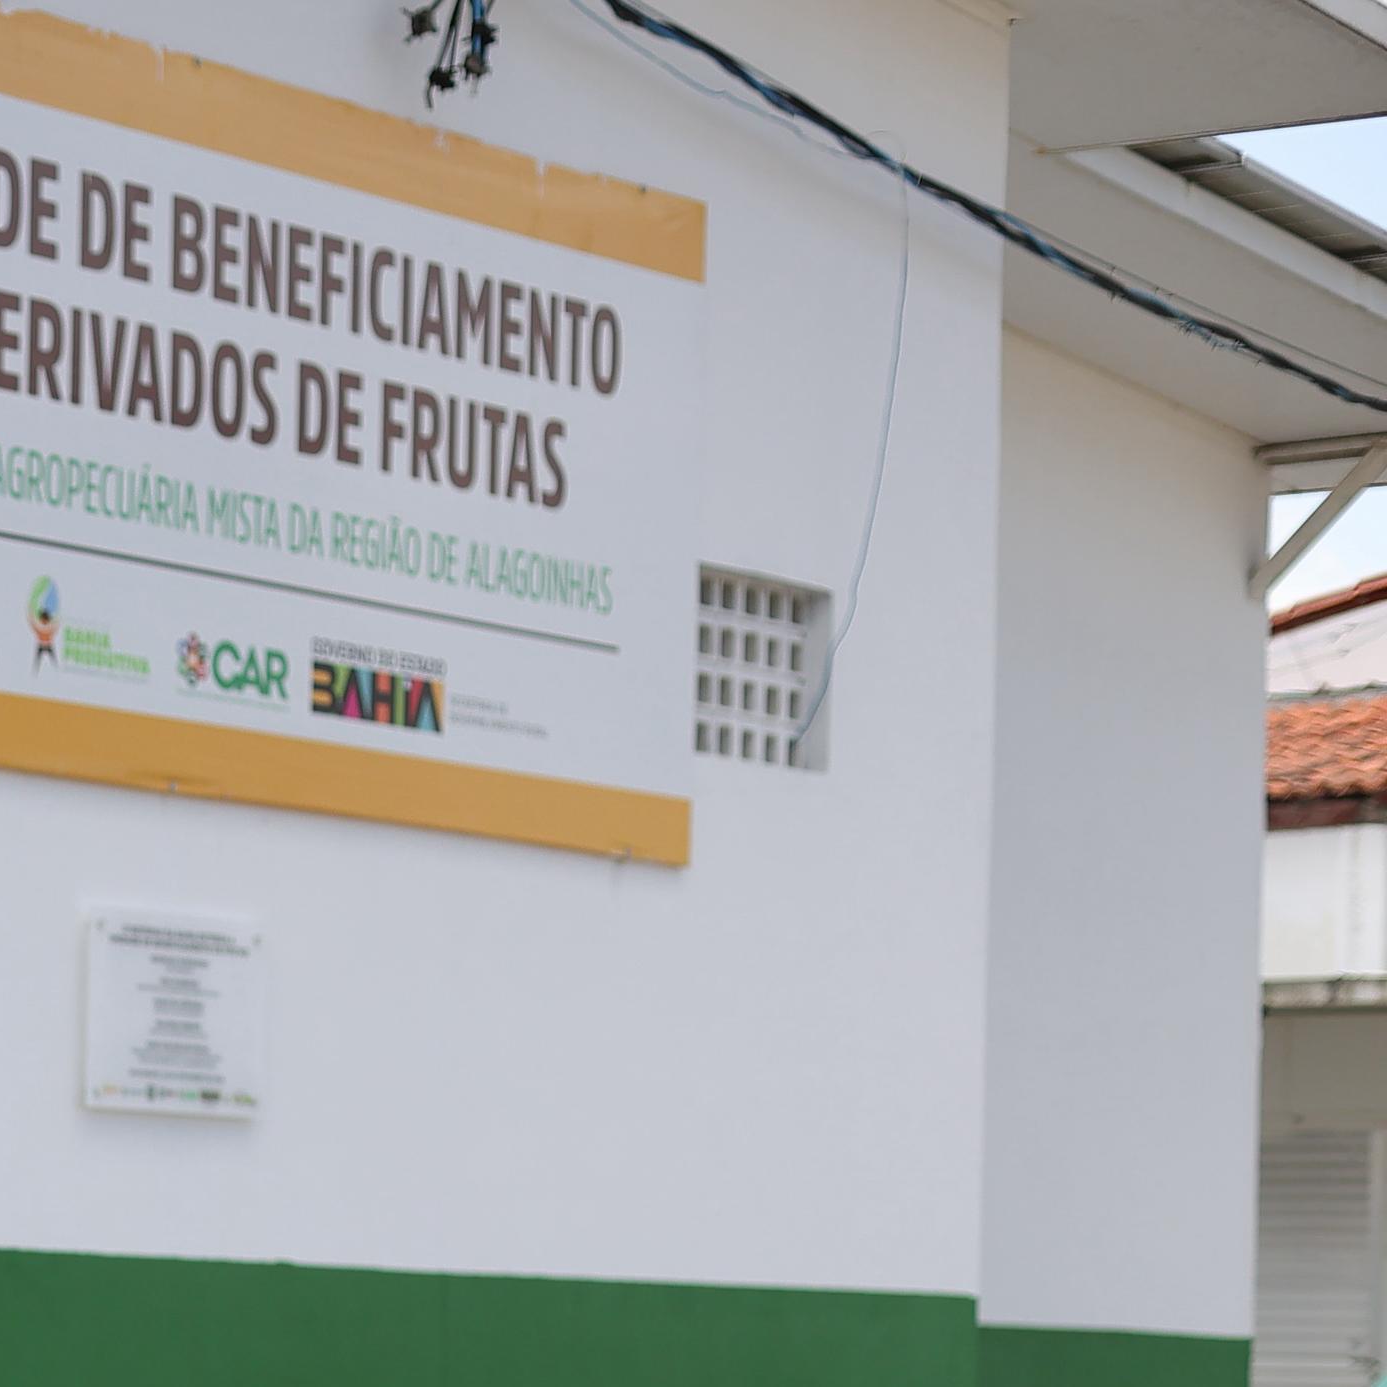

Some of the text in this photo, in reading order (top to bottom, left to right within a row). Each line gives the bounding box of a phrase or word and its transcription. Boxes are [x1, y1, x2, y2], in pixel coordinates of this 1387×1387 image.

[78, 174, 152, 283] DE
[170, 195, 621, 396] BENEFICIAMENTO
[296, 361, 363, 465] DE
[380, 382, 567, 510] FRUTAS
[206, 485, 281, 551] MISTA
[288, 502, 324, 559] DA
[330, 510, 422, 577] REGIÃO
[428, 530, 461, 585] DE
[464, 541, 614, 615] ALAGOINHAS
[211, 639, 289, 700] CAR
[311, 636, 376, 663] GOVERNO
[399, 650, 446, 675] ESTADO
[311, 659, 444, 732] BAHIA
